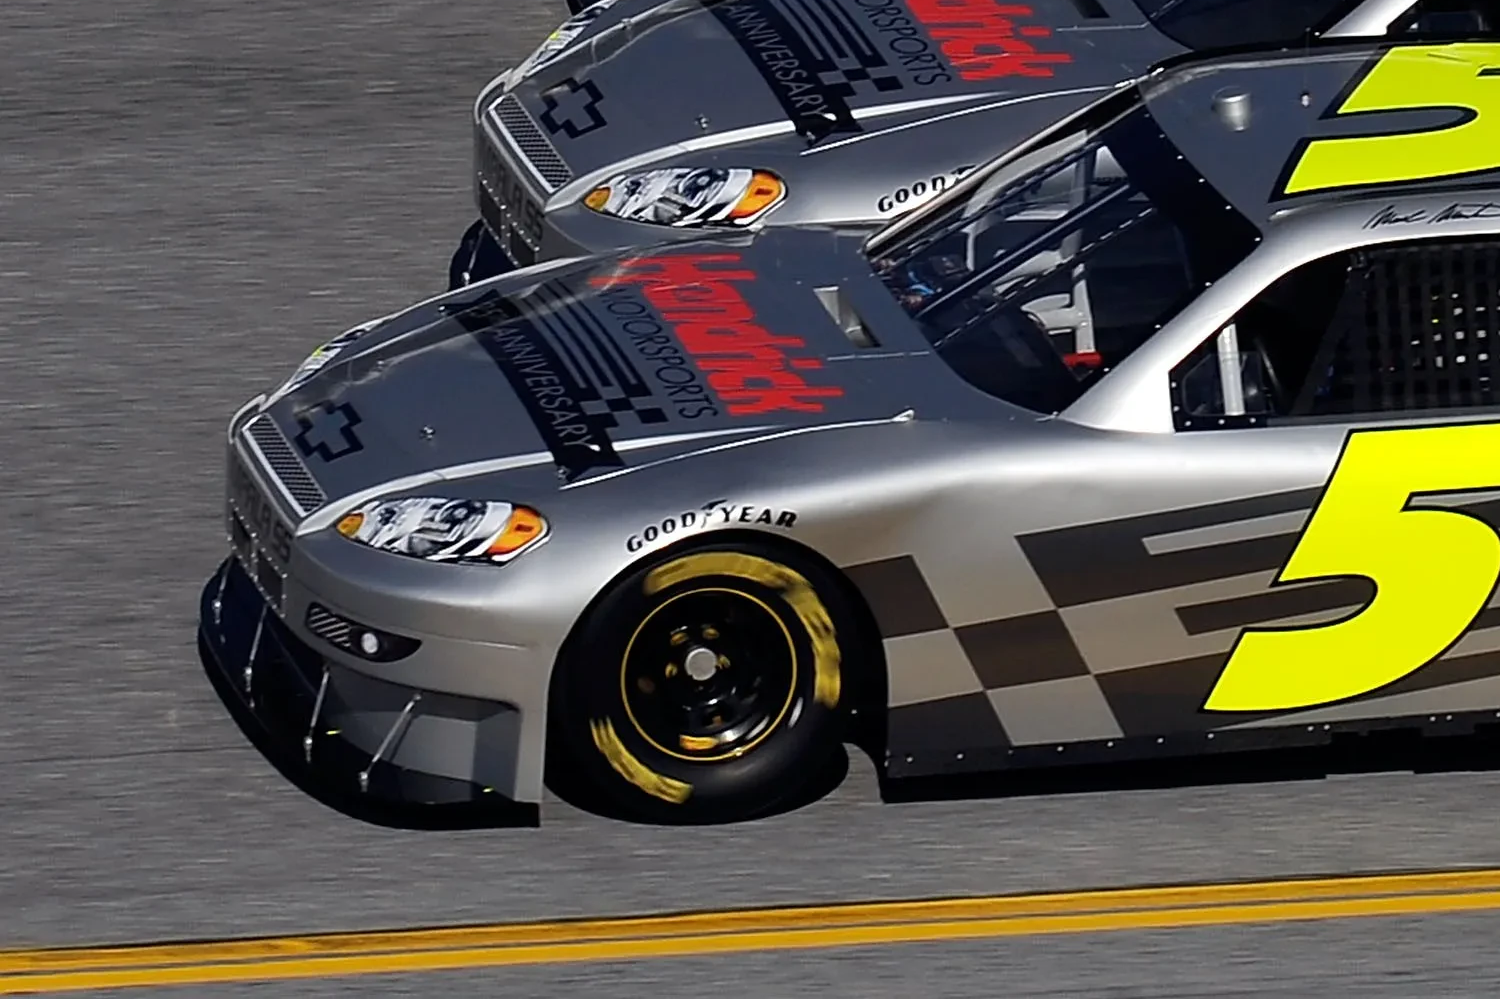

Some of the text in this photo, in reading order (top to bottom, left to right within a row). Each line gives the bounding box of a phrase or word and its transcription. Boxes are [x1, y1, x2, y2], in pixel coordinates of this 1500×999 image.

[720, 3, 829, 117] ANNIVERSARY
[493, 323, 594, 447] ANNIVERSARY
[587, 254, 846, 417] Hendrick
